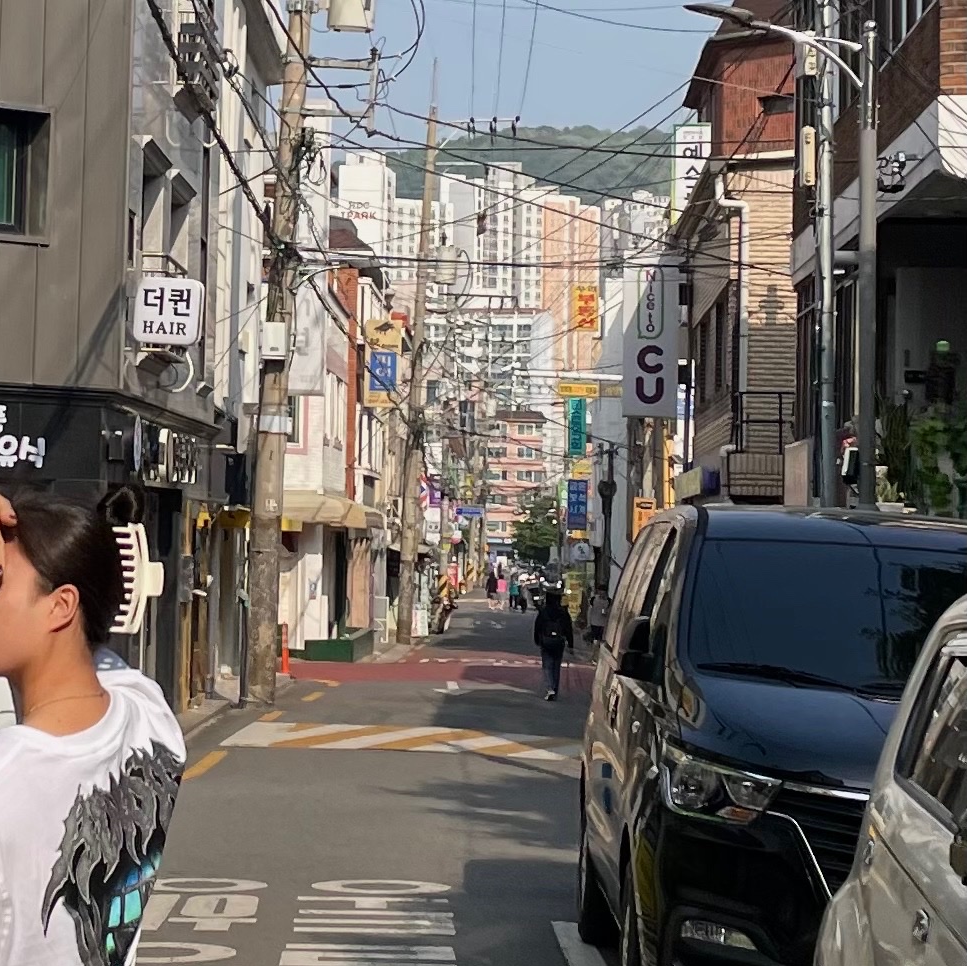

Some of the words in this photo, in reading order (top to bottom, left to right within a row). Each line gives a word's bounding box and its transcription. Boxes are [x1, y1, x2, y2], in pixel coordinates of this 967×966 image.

[143, 287, 192, 317] 더퀸
[142, 320, 187, 336] HAIR
[636, 345, 664, 404] CU
